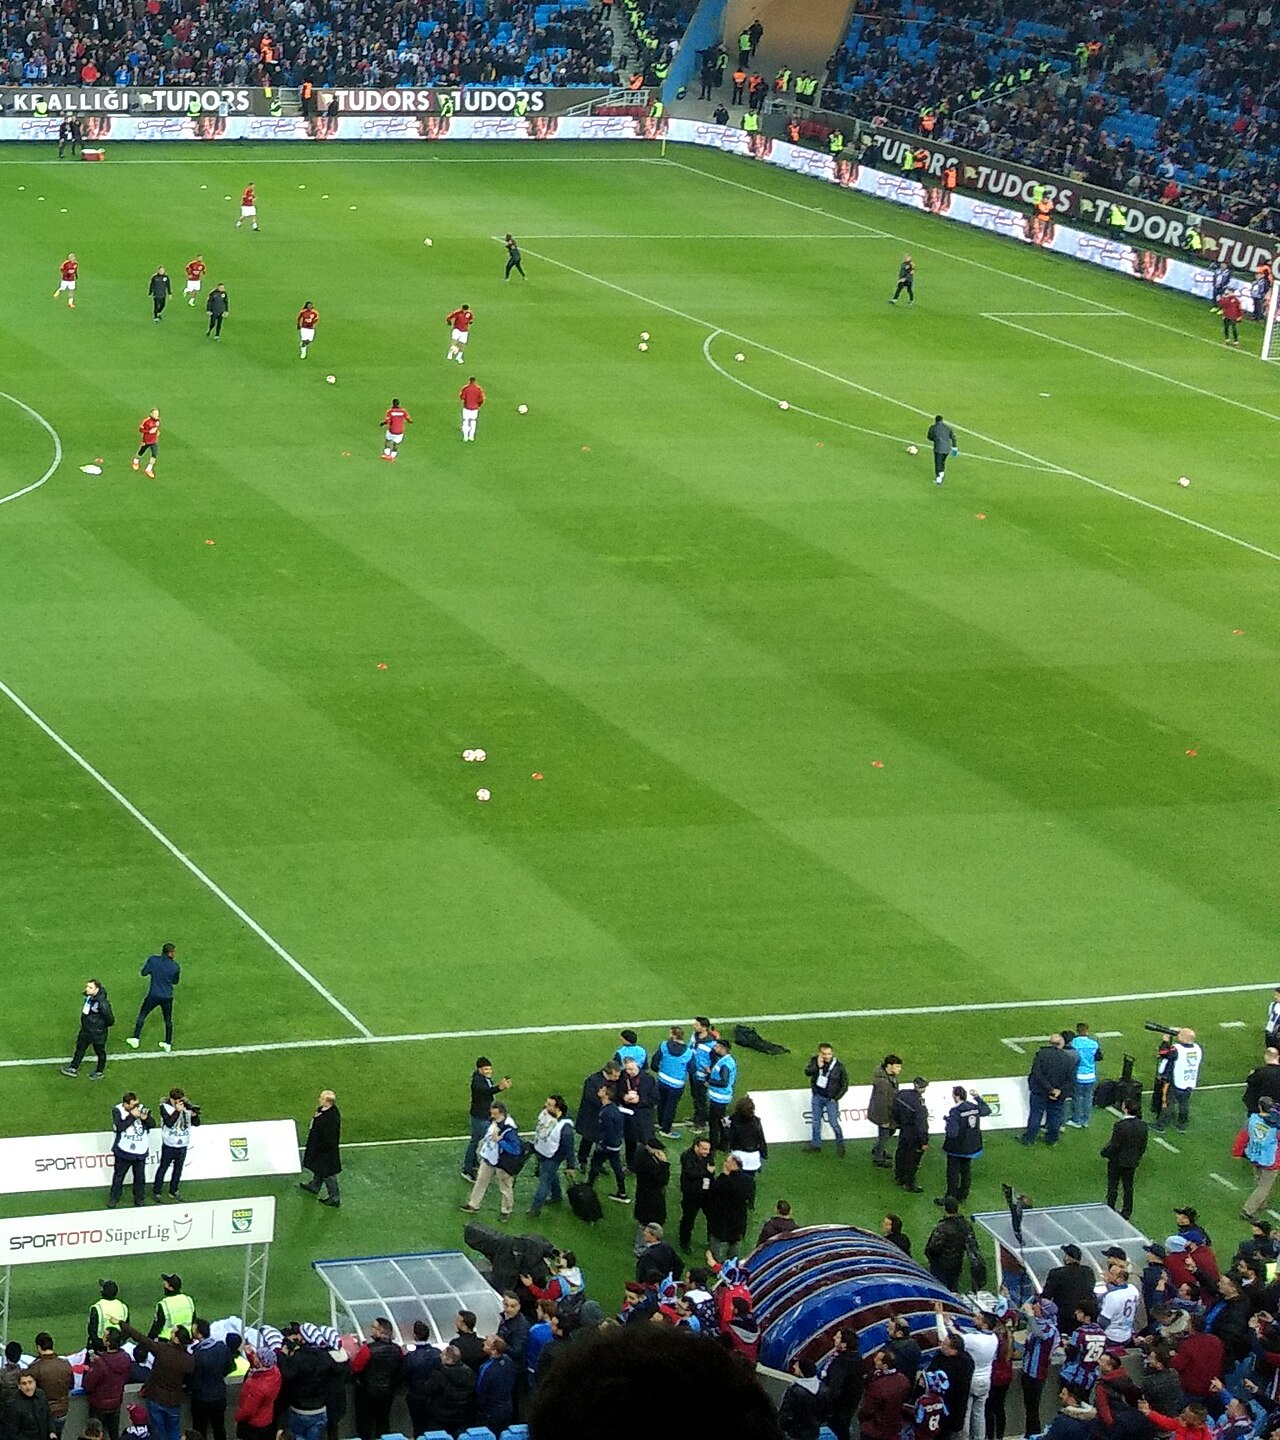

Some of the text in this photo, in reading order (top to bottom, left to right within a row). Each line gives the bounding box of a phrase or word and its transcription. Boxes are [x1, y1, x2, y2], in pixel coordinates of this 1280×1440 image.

[335, 90, 430, 111] TUDORS
[450, 90, 544, 111] TUDORS
[1094, 199, 1196, 250] TDORS
[10, 1224, 170, 1250] SPORTOTO SüperLig
[1083, 1341, 1104, 1363] 25
